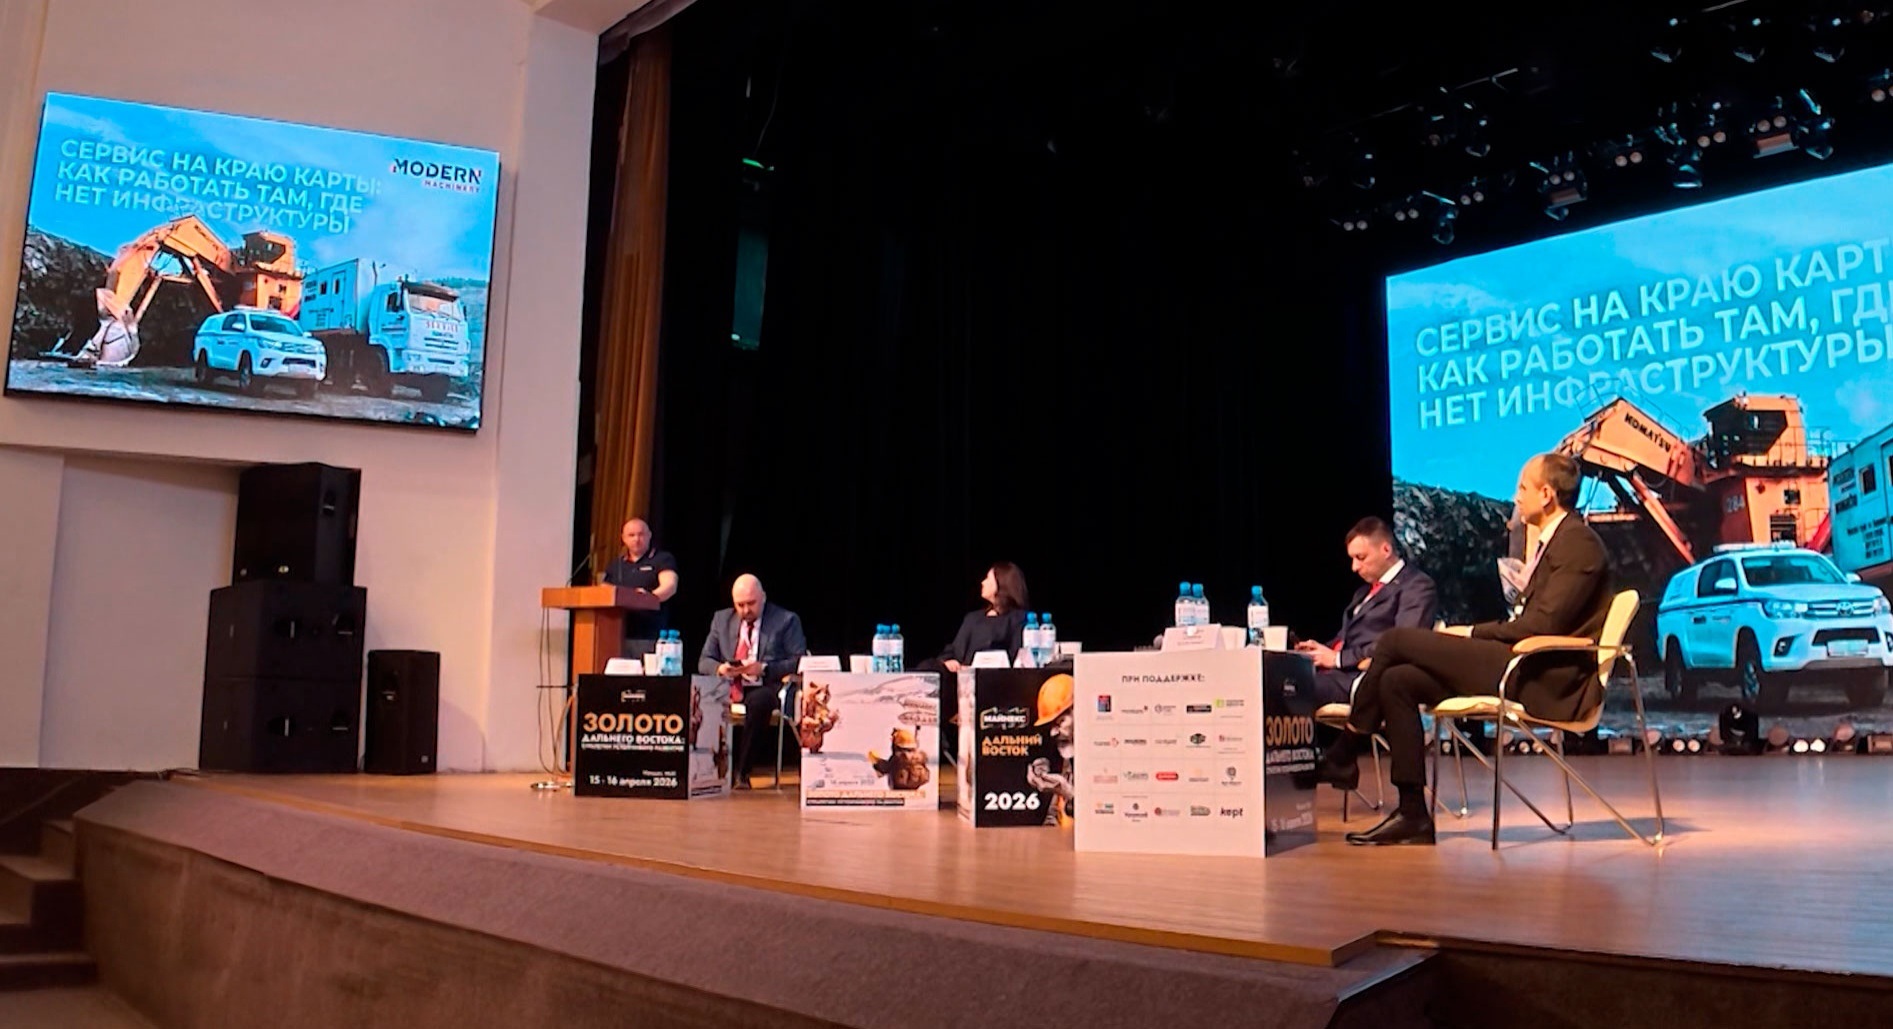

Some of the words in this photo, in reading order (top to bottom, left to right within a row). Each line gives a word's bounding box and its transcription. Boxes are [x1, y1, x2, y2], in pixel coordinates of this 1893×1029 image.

[61, 138, 165, 169] СЕРВИС
[173, 151, 208, 174] НА
[215, 157, 287, 184] КРАЮ
[294, 167, 382, 196] КАРТЫ:
[392, 158, 482, 184] MODERN
[57, 161, 111, 185] КАК
[119, 168, 249, 200] РАБОТАТЬ
[257, 184, 313, 212] ТАМ,
[320, 192, 363, 215] ГДЕ
[55, 182, 107, 206] НЕТ
[112, 190, 349, 235] ИНФРАСТРУКТУРЫ
[1416, 303, 1562, 357] СЕРВИС
[1574, 290, 1630, 329] НА
[1640, 264, 1763, 317] КРАЮ
[1775, 237, 1893, 292] КАРТ
[1418, 354, 1489, 394] КАК
[1501, 318, 1705, 380] РАБОТАТЬ
[1714, 296, 1820, 343] ТАМ,
[1831, 280, 1893, 328] ГД
[1420, 391, 1488, 430] НЕТ
[1624, 411, 1671, 453] KOMATSU
[1122, 675, 1140, 683] ПРИ
[1143, 673, 1205, 683] ПОДДЕРЖКЕ:
[583, 712, 684, 734] ЗОЛОТО
[1266, 716, 1314, 746] ЗОЛОТО
[581, 733, 635, 744] ДАЛЬНЕГО
[636, 734, 685, 744] ВОСТОКА:
[981, 734, 1042, 746] ДАЛЬНИЙ
[981, 745, 1029, 757] ВОСТОК
[589, 775, 600, 785] 15
[607, 775, 618, 786] 16
[619, 778, 652, 789] апреля
[653, 777, 678, 788] 2026
[984, 791, 1041, 811] 2026
[1220, 807, 1243, 819] kept
